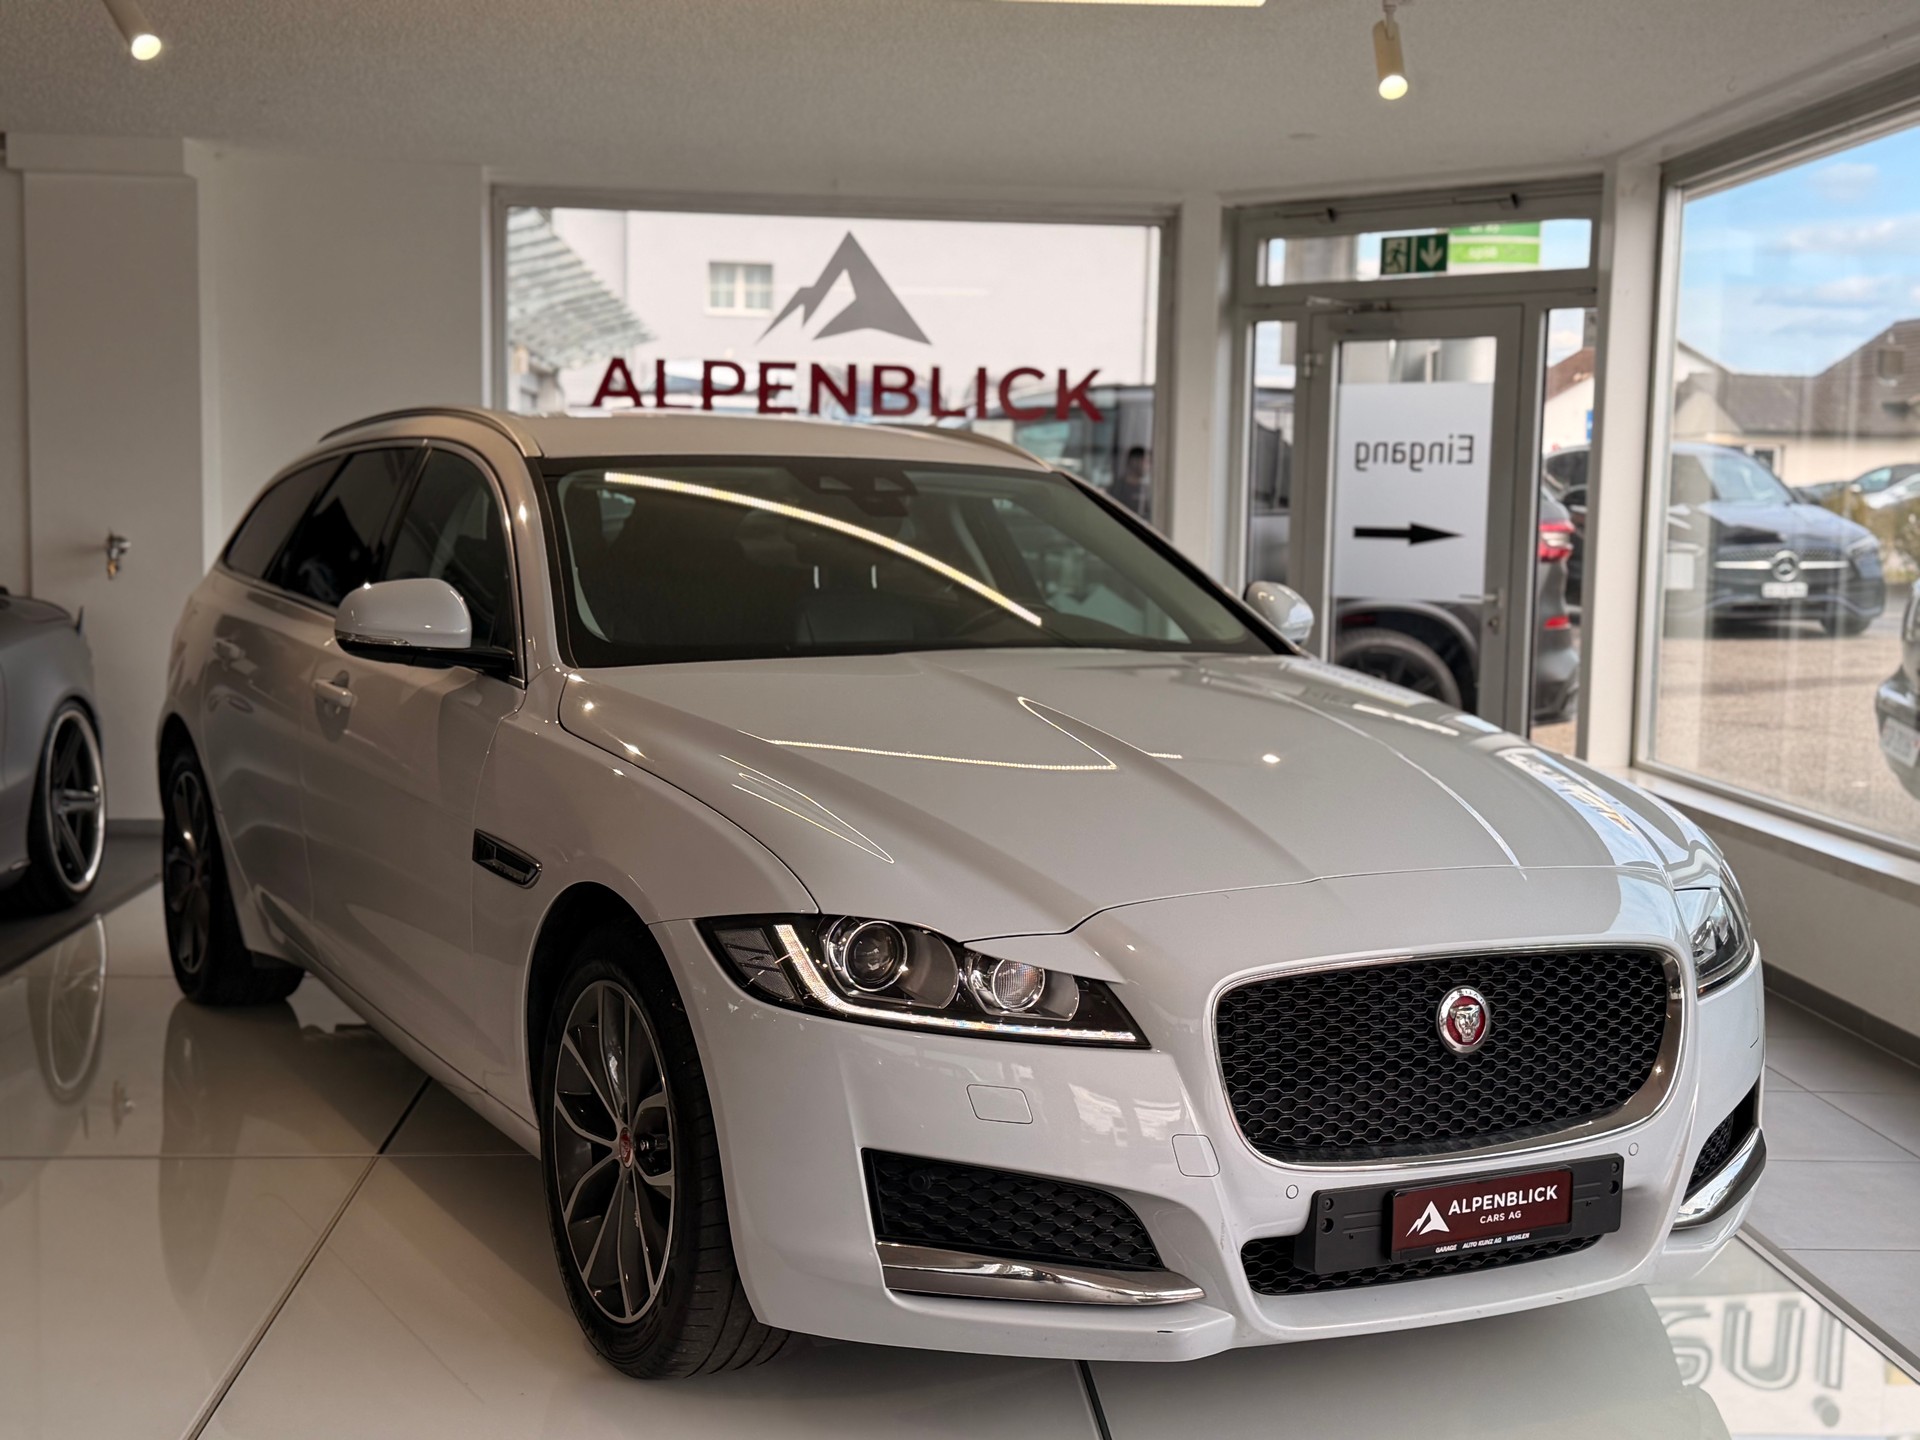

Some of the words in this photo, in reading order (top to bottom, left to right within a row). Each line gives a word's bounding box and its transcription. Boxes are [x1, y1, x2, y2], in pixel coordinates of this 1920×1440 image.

[591, 357, 1104, 423] ALPENBLICK
[1448, 1184, 1558, 1215] ALPENBLICK
[1479, 1213, 1506, 1224] CARS
[1508, 1210, 1522, 1221] AG
[1435, 1244, 1457, 1253] GARAGE
